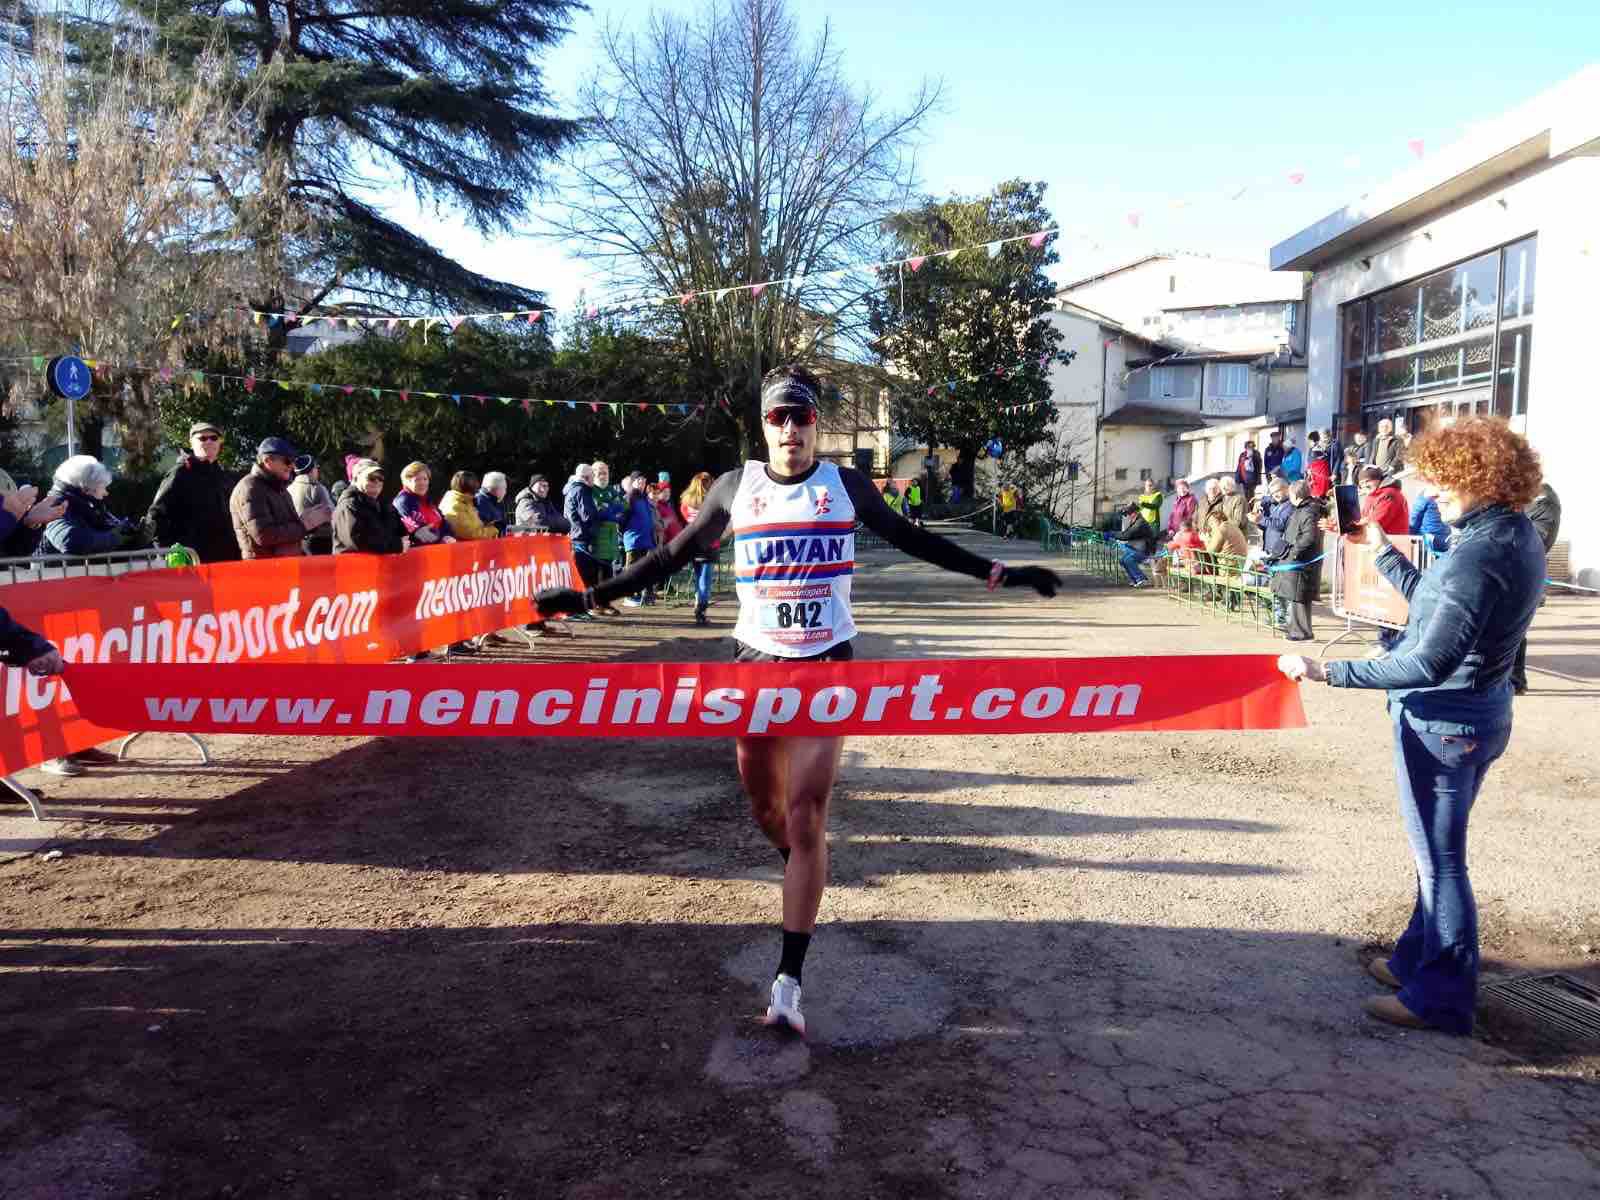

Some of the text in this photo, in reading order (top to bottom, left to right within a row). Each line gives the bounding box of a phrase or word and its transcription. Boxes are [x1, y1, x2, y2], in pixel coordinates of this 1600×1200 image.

[744, 538, 845, 565] LUIVAN
[415, 555, 574, 620] nencinisport.com
[777, 601, 823, 628] 842
[144, 674, 1142, 733] www.nencinisport.com
